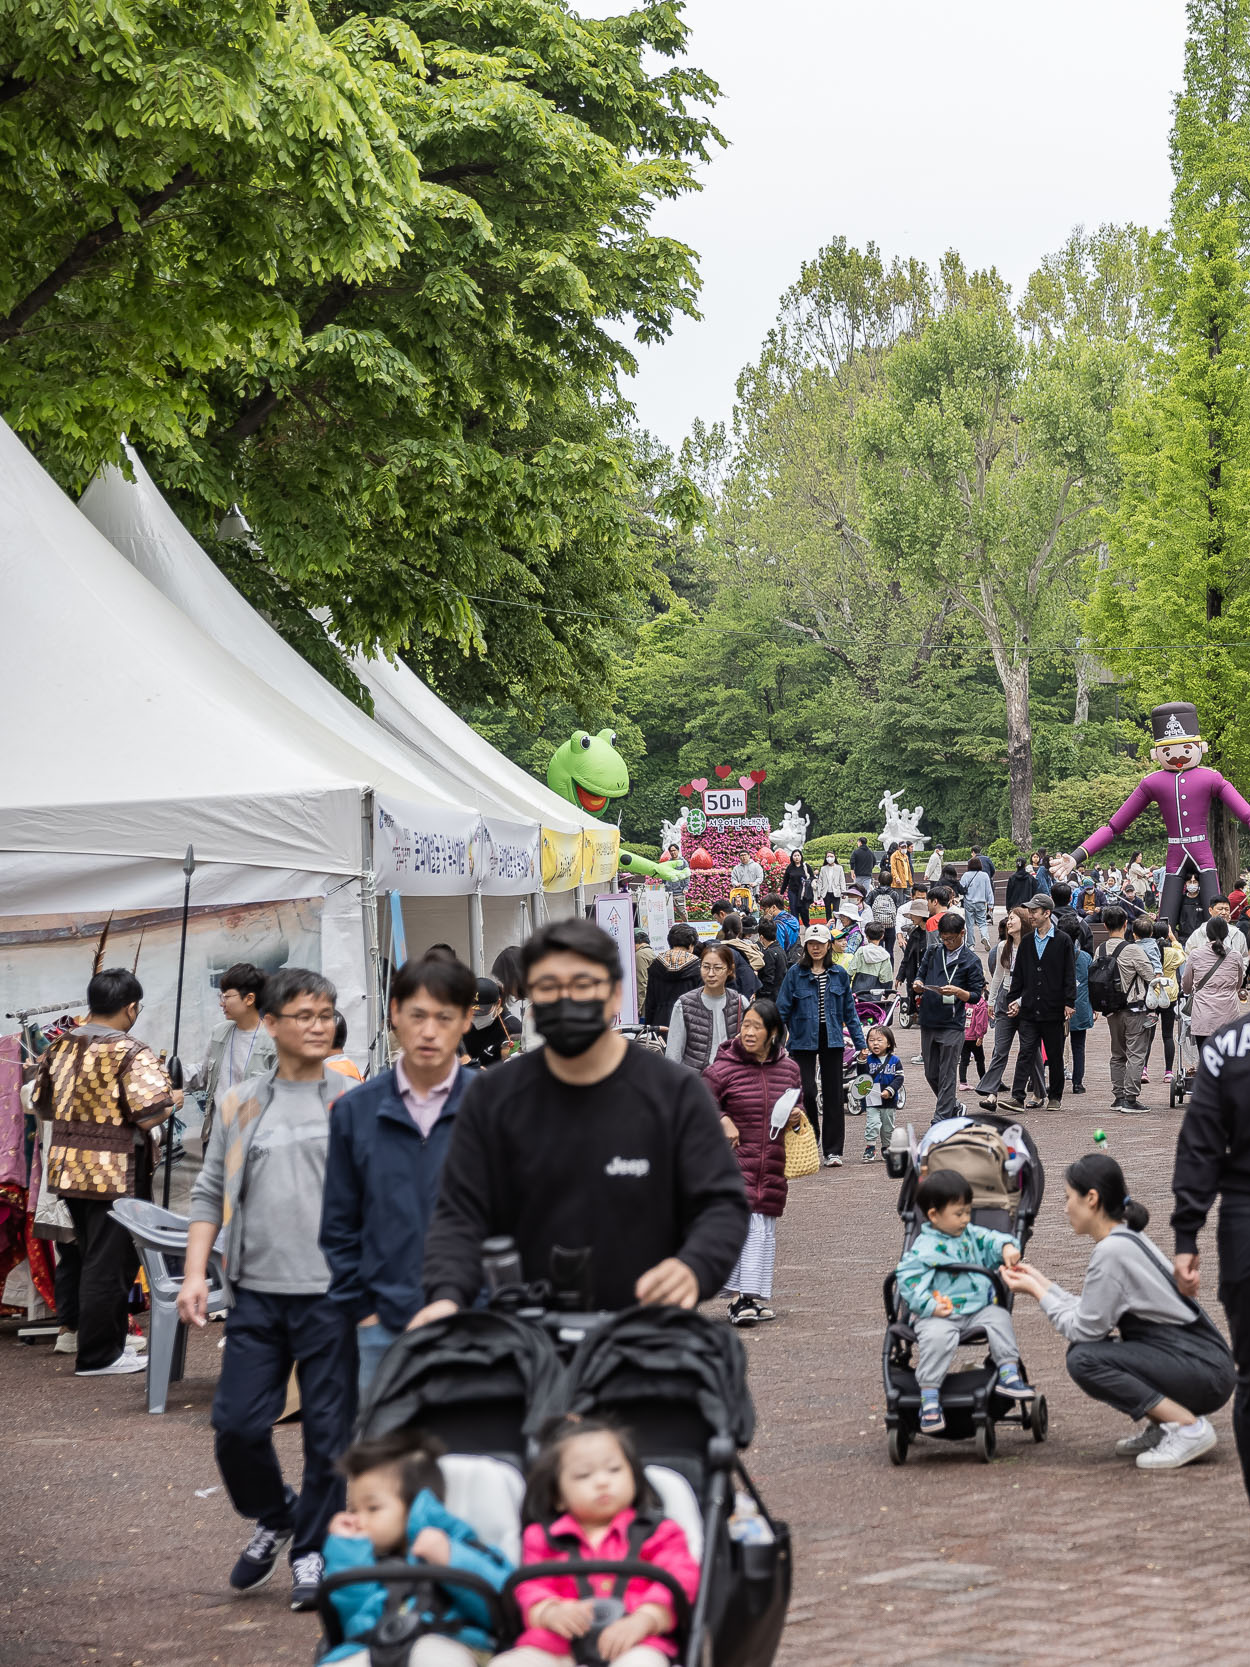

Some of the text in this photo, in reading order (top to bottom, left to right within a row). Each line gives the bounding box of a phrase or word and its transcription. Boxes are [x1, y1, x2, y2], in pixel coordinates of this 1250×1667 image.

[707, 793, 744, 811] 50th
[708, 818, 769, 833] 서울어린이대공원
[606, 1156, 650, 1177] Jeep
